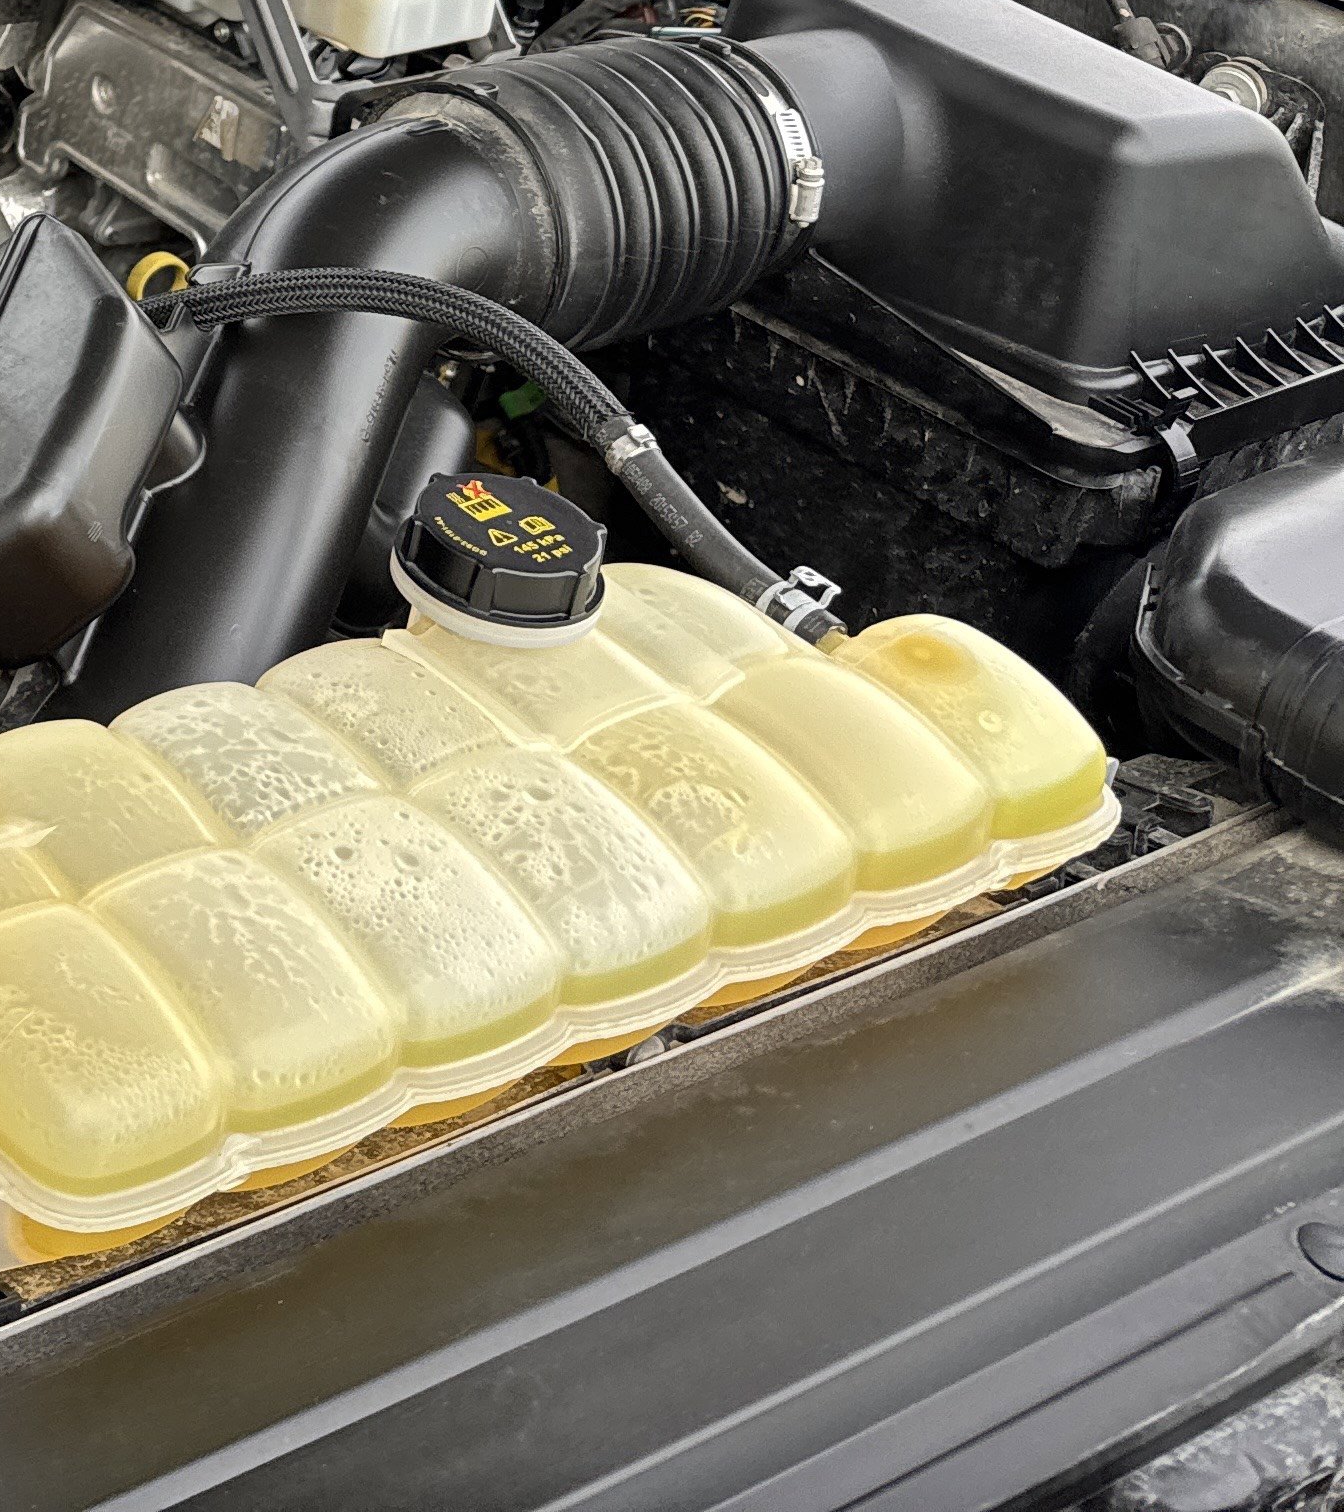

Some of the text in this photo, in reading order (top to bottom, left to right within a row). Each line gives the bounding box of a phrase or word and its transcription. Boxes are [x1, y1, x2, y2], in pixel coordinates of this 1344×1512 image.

[514, 534, 565, 554] 145 kPa
[532, 544, 573, 563] 21 psi
